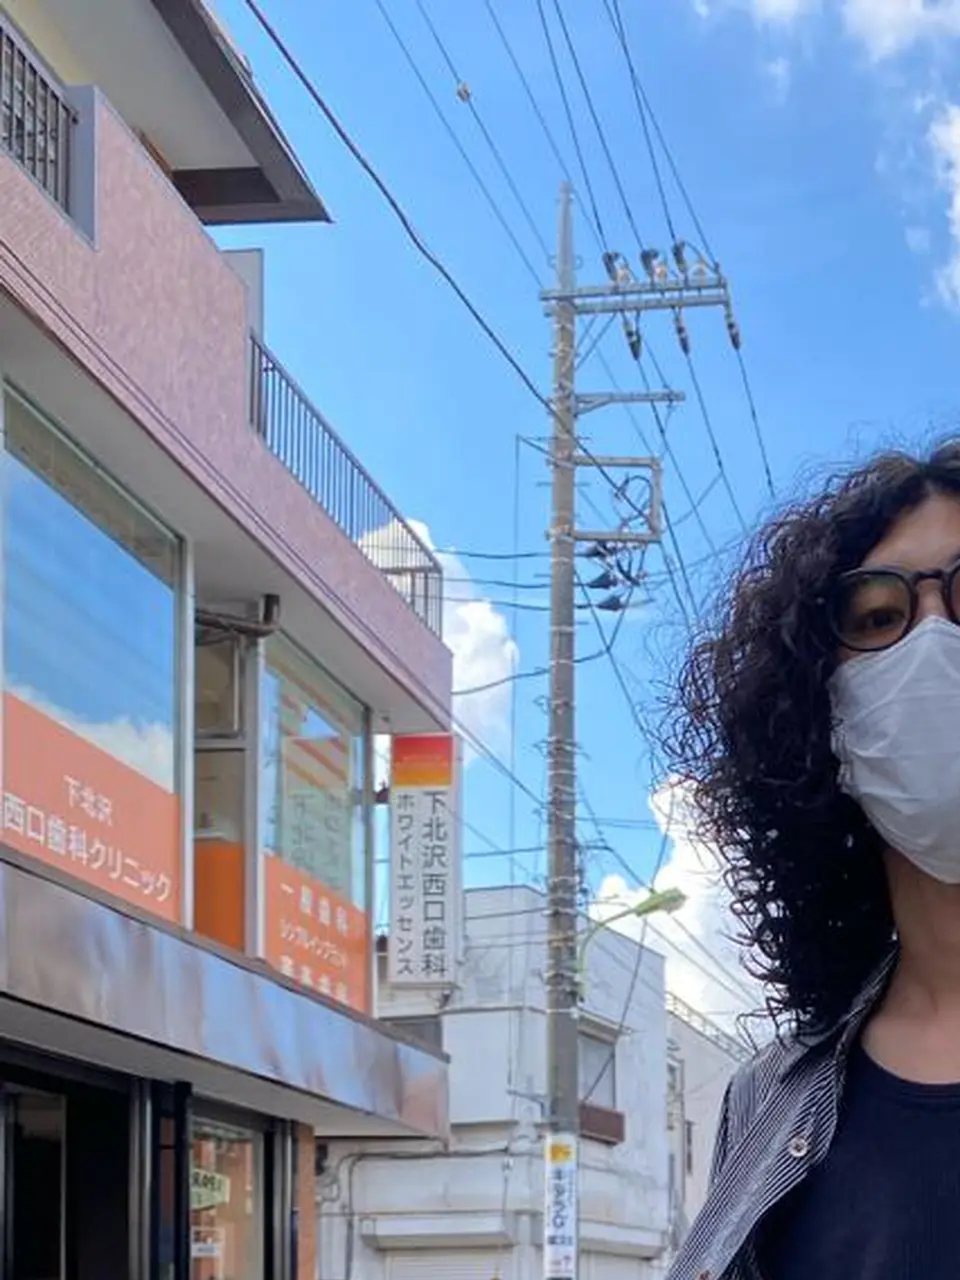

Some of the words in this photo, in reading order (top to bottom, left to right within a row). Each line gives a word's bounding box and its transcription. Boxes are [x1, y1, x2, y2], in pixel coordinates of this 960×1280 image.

[4, 791, 172, 902] 西口歯科クリニック
[396, 792, 414, 976] ホワイトエッセンス
[421, 790, 448, 978] 下北沢西口歯科
